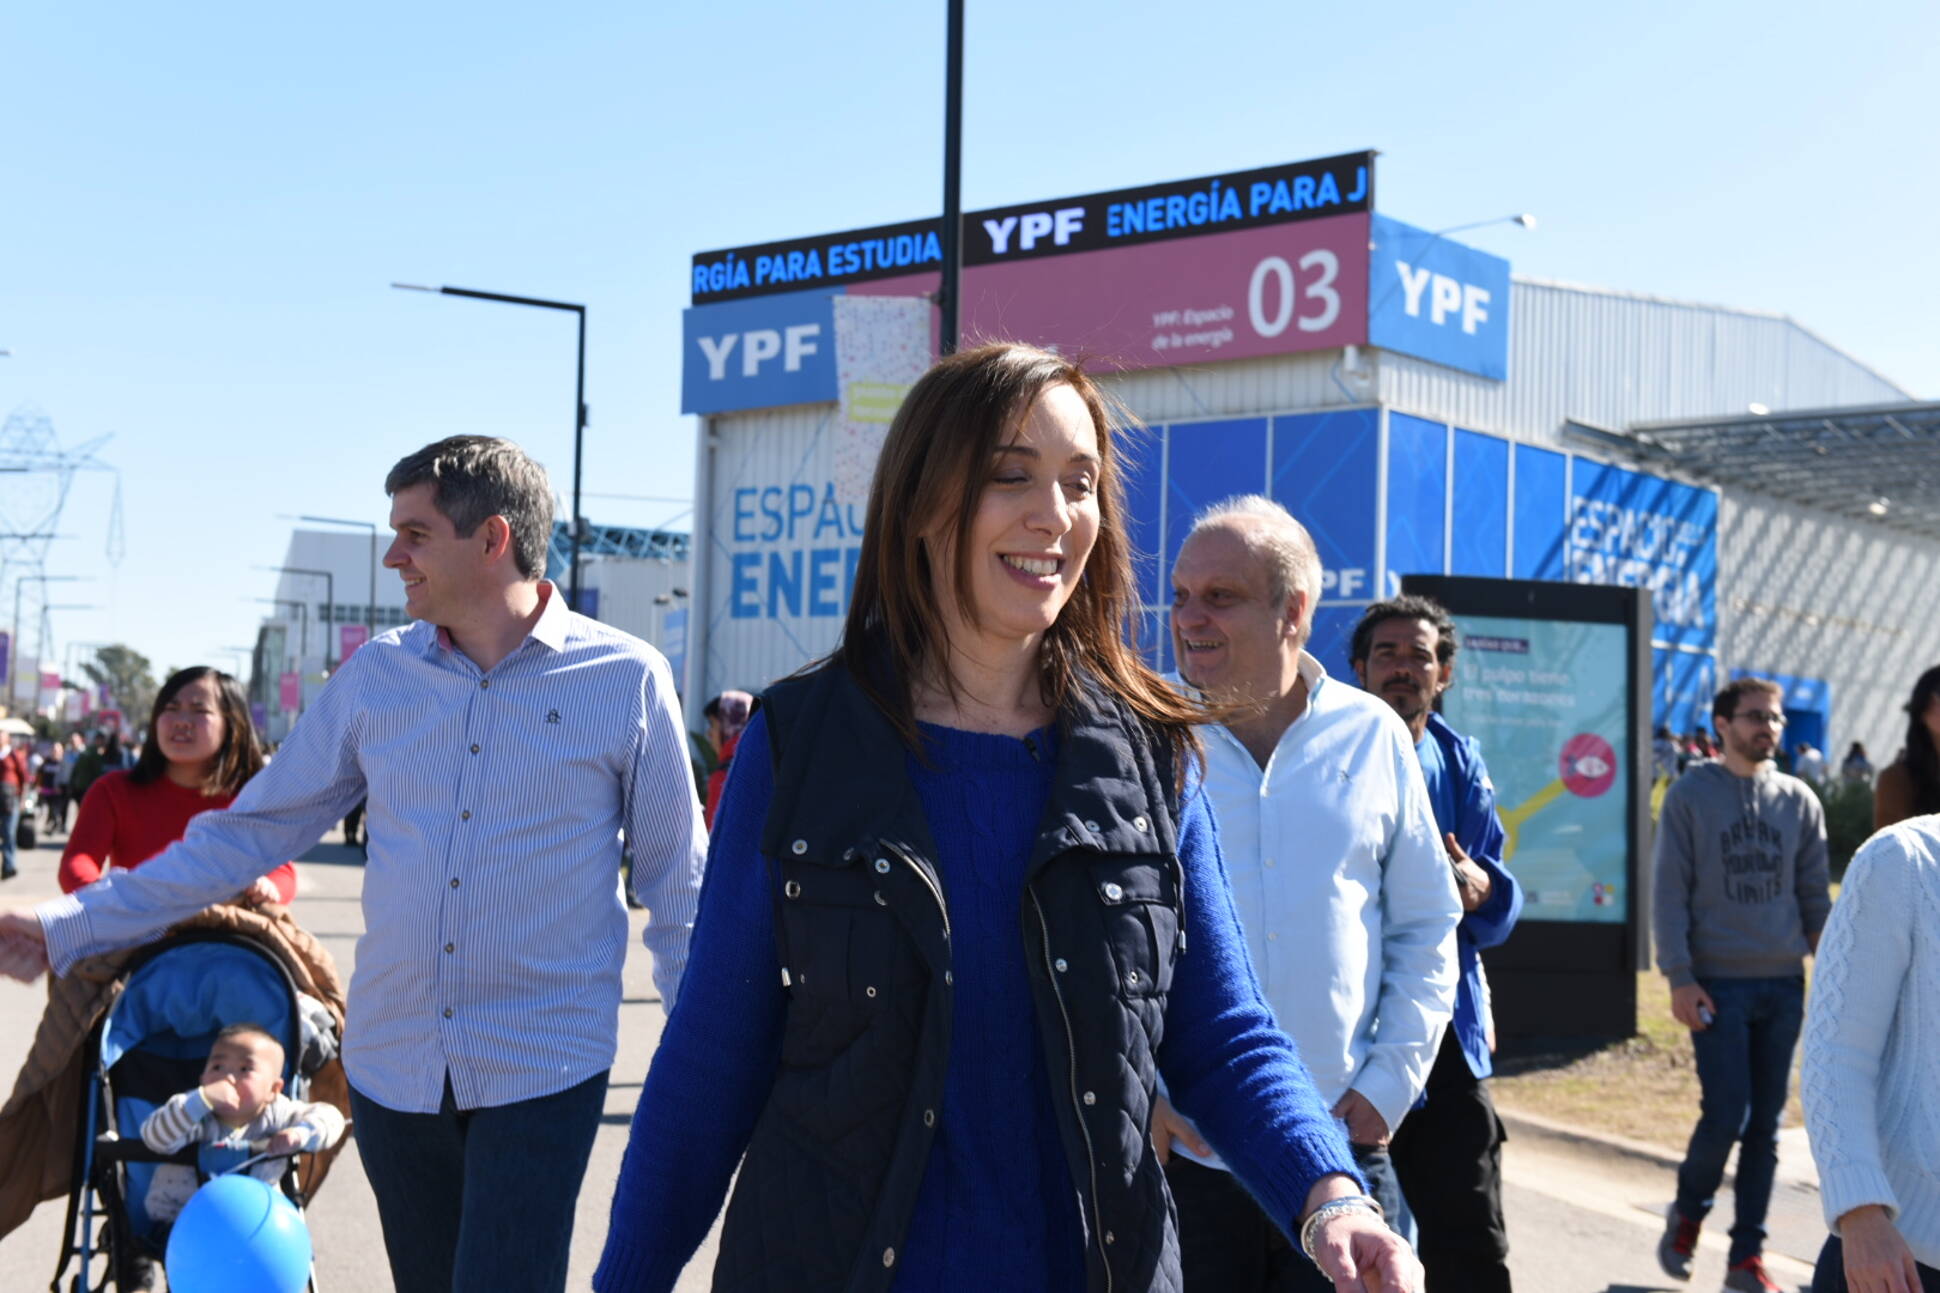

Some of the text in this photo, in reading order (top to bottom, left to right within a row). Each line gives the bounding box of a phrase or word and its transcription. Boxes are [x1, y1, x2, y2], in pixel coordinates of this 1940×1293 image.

[755, 250, 822, 285] PARA
[828, 231, 942, 276] ESTUDIA
[982, 207, 1086, 254] YPF
[1107, 180, 1243, 236] ENERGÍA
[1250, 172, 1341, 217] PARA
[1347, 166, 1368, 201] J
[1249, 249, 1341, 338] 03
[1395, 259, 1491, 336] YPF
[697, 324, 821, 381] YPF
